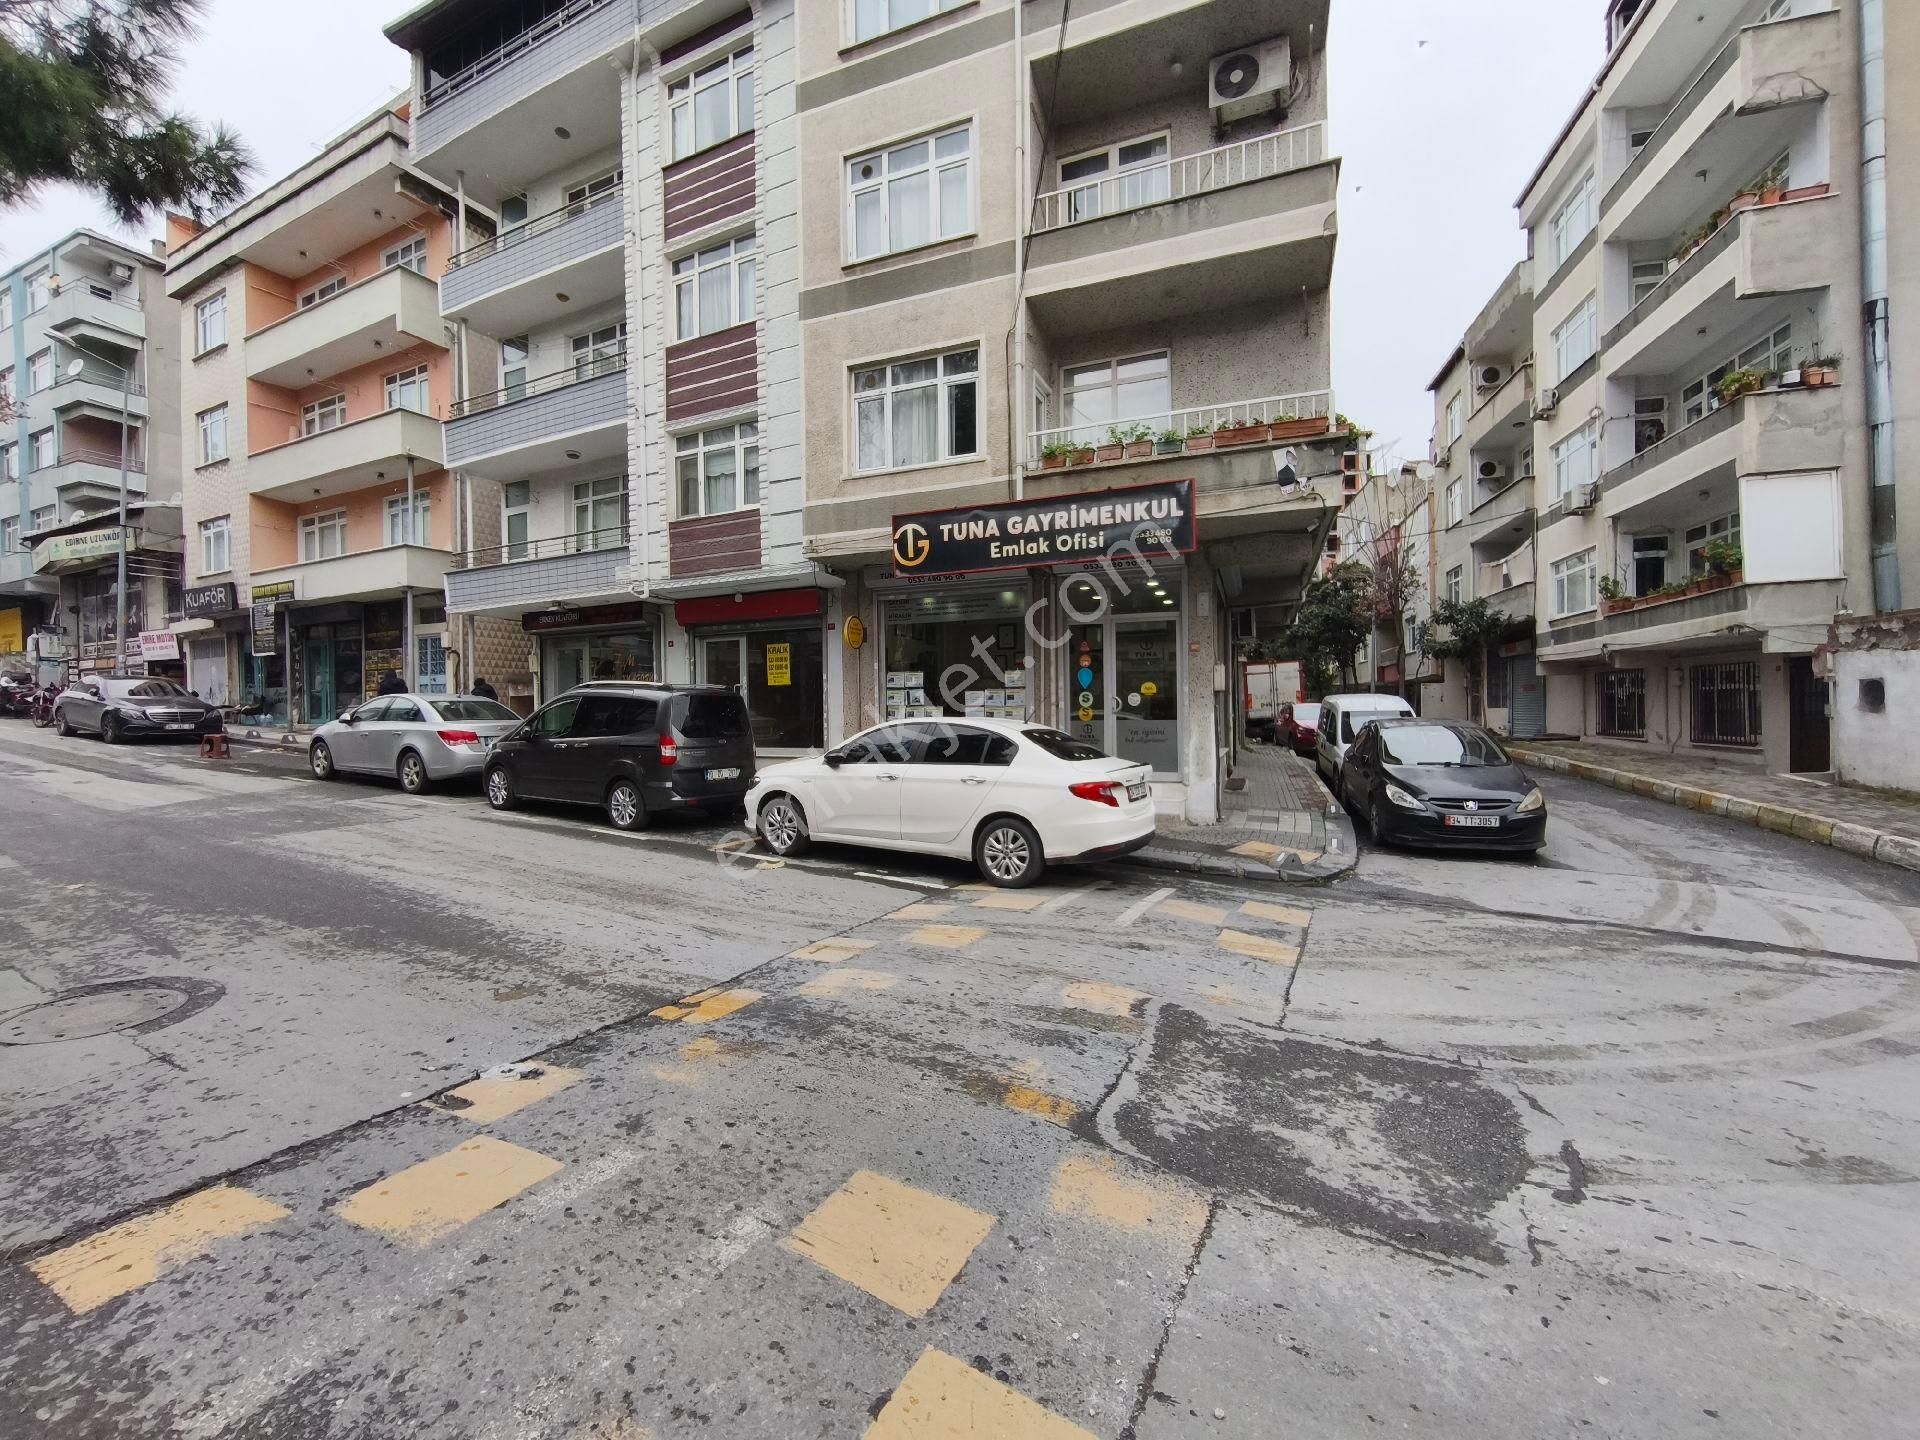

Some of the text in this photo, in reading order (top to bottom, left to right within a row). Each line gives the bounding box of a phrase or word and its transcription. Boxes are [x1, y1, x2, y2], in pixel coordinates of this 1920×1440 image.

[940, 497, 1184, 541] TUNA GAYRİMENKUL
[990, 531, 1105, 559] Emlak Ofisi
[185, 587, 226, 608] KUAFÖR
[1477, 816, 1498, 826] 3057
